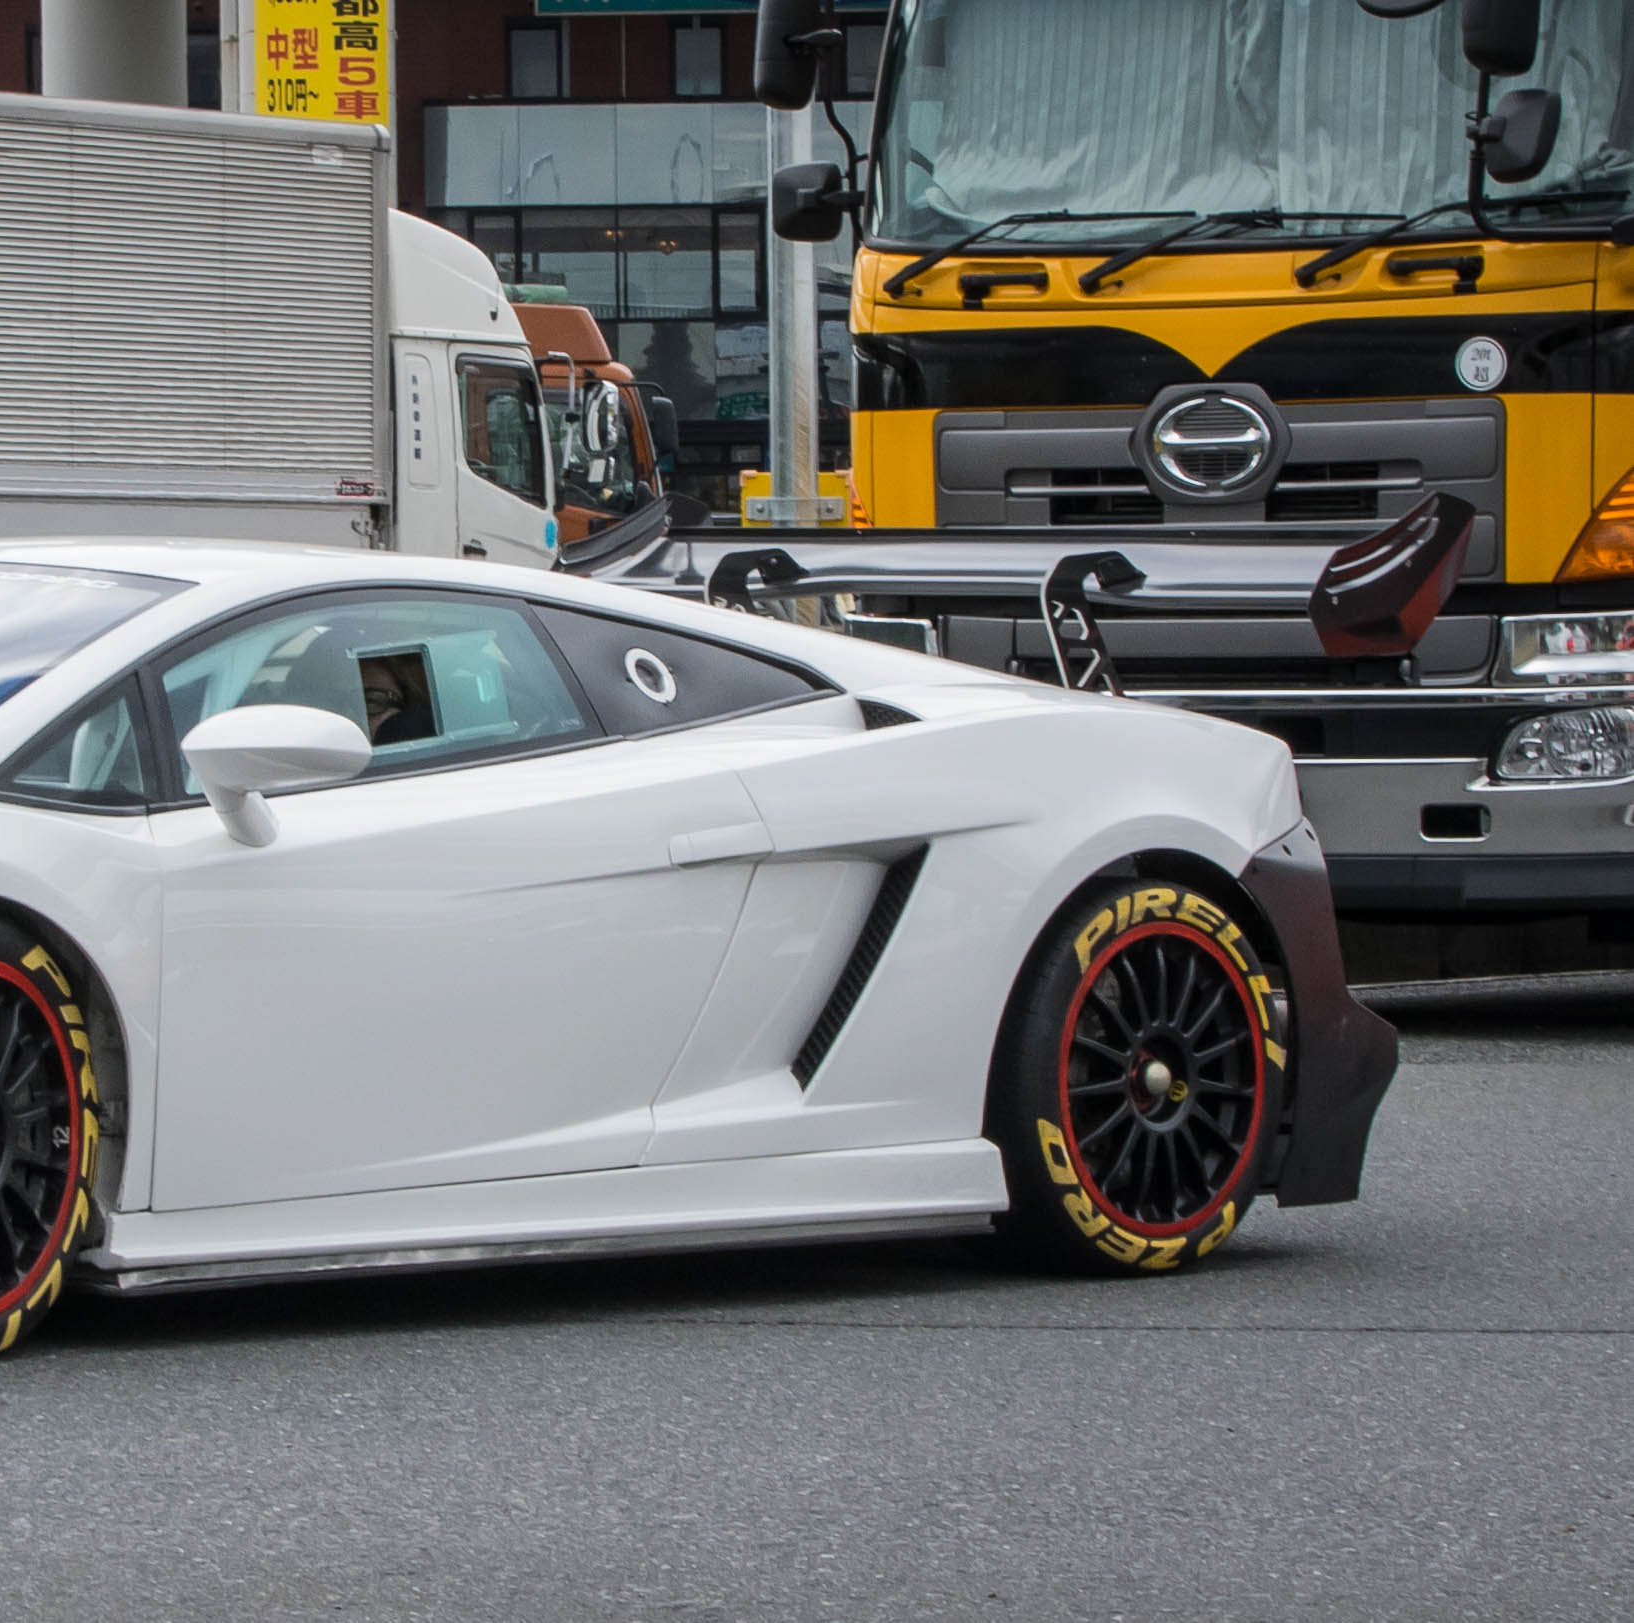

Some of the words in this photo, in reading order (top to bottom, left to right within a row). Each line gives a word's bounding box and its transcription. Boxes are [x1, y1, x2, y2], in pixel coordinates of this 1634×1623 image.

[267, 27, 319, 71] 中型
[1072, 887, 1286, 1071] PIRELLI
[1036, 1118, 1188, 1270] ZERO
[1197, 1200, 1236, 1258] P
